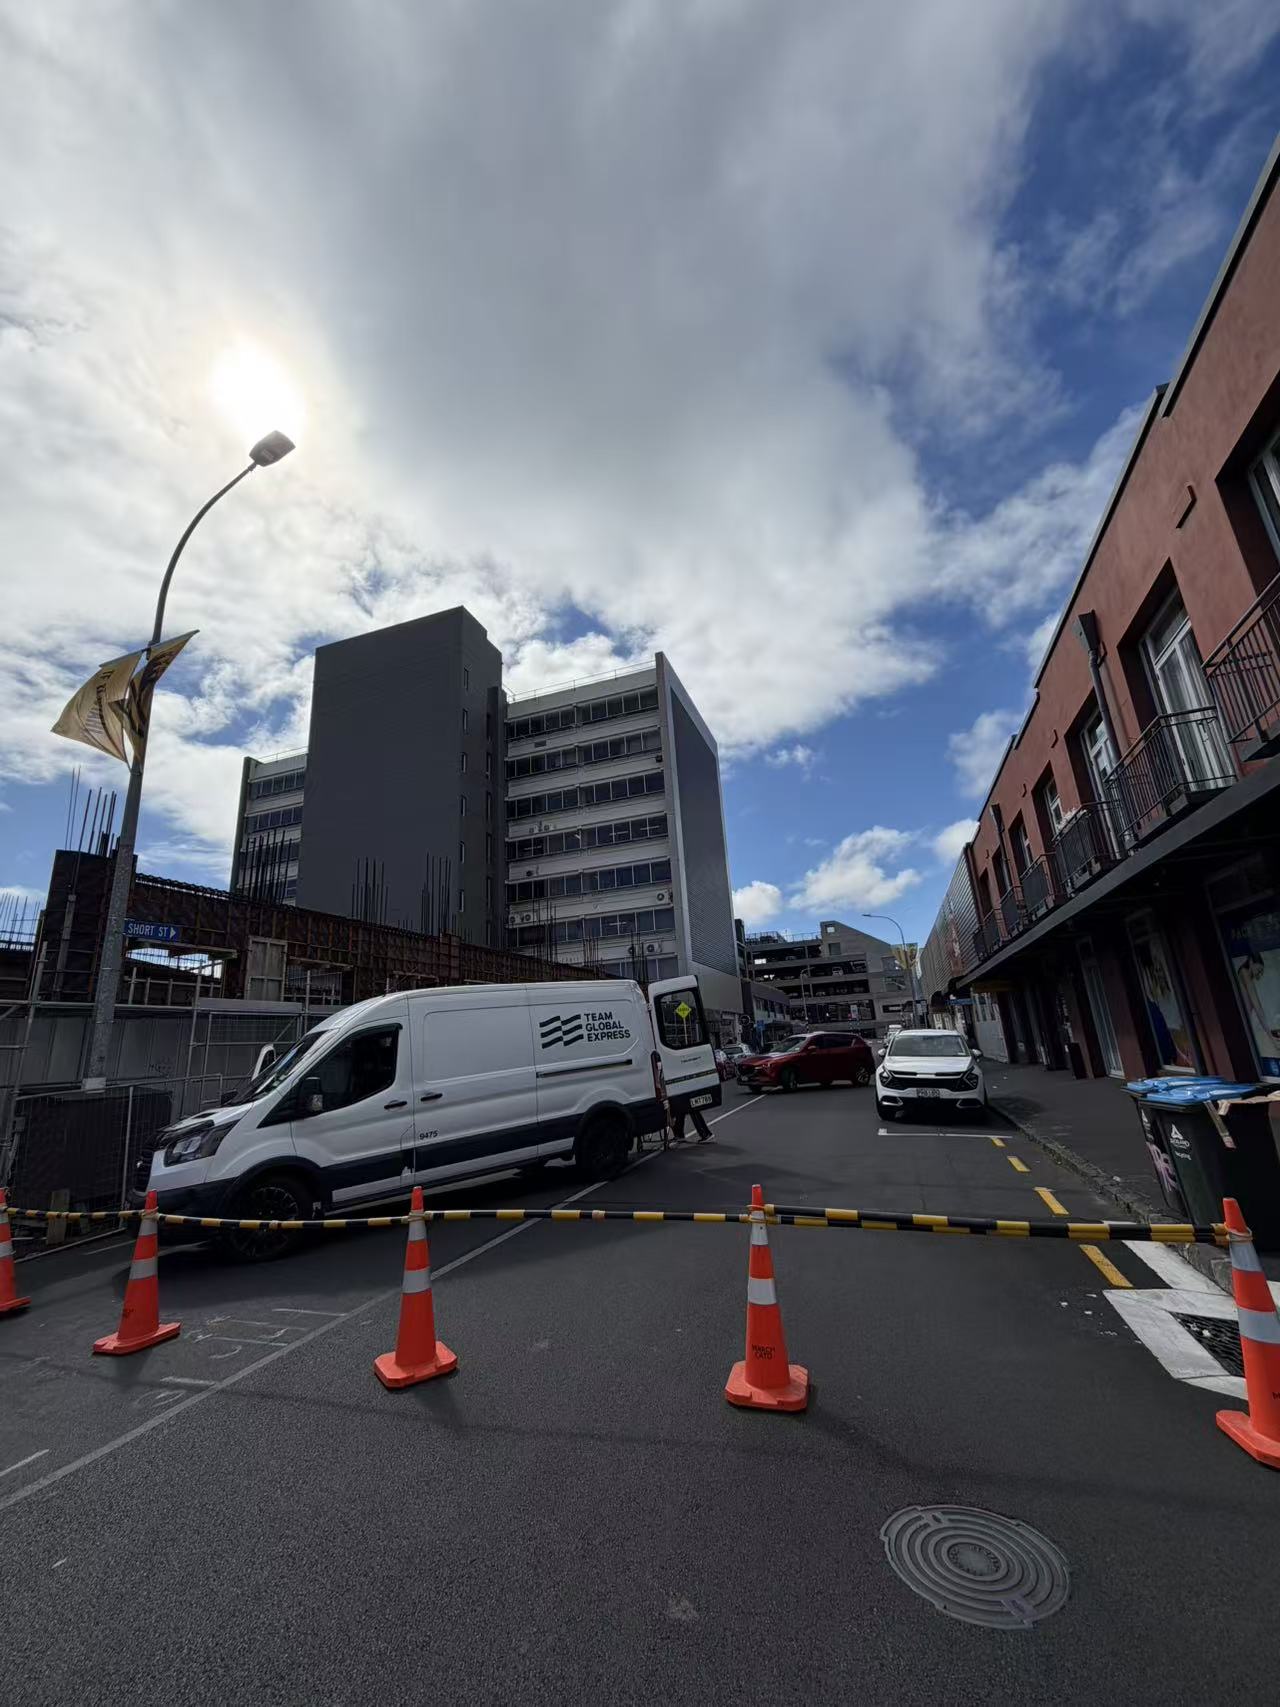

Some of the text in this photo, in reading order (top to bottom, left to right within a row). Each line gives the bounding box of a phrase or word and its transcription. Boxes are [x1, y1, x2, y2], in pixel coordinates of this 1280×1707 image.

[127, 923, 169, 937] SHORT ST
[584, 1011, 613, 1022] TEAM
[585, 1020, 625, 1033] GLOBAL
[586, 1029, 631, 1042] EXPRESS
